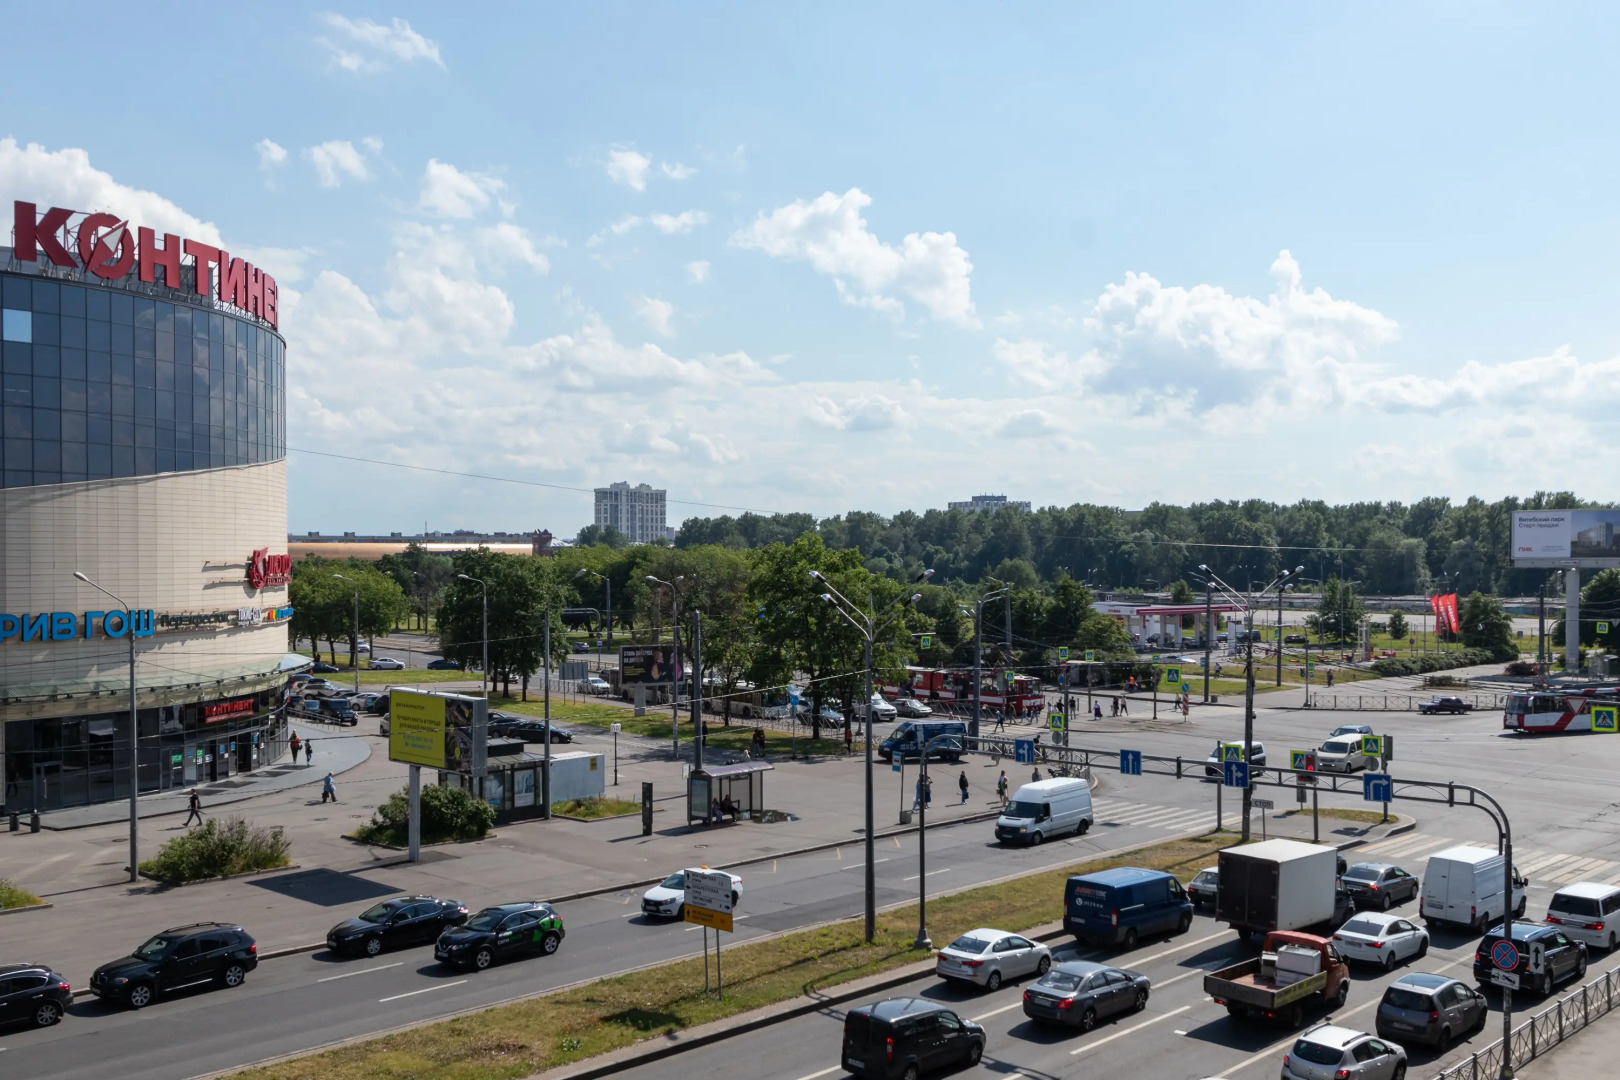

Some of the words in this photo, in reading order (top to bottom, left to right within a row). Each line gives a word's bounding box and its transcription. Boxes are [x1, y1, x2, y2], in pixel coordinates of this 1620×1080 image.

[14, 200, 279, 331] КОНТИНЕ
[84, 609, 154, 639] ГОШ
[204, 698, 255, 716] КОНТИНЕНТ
